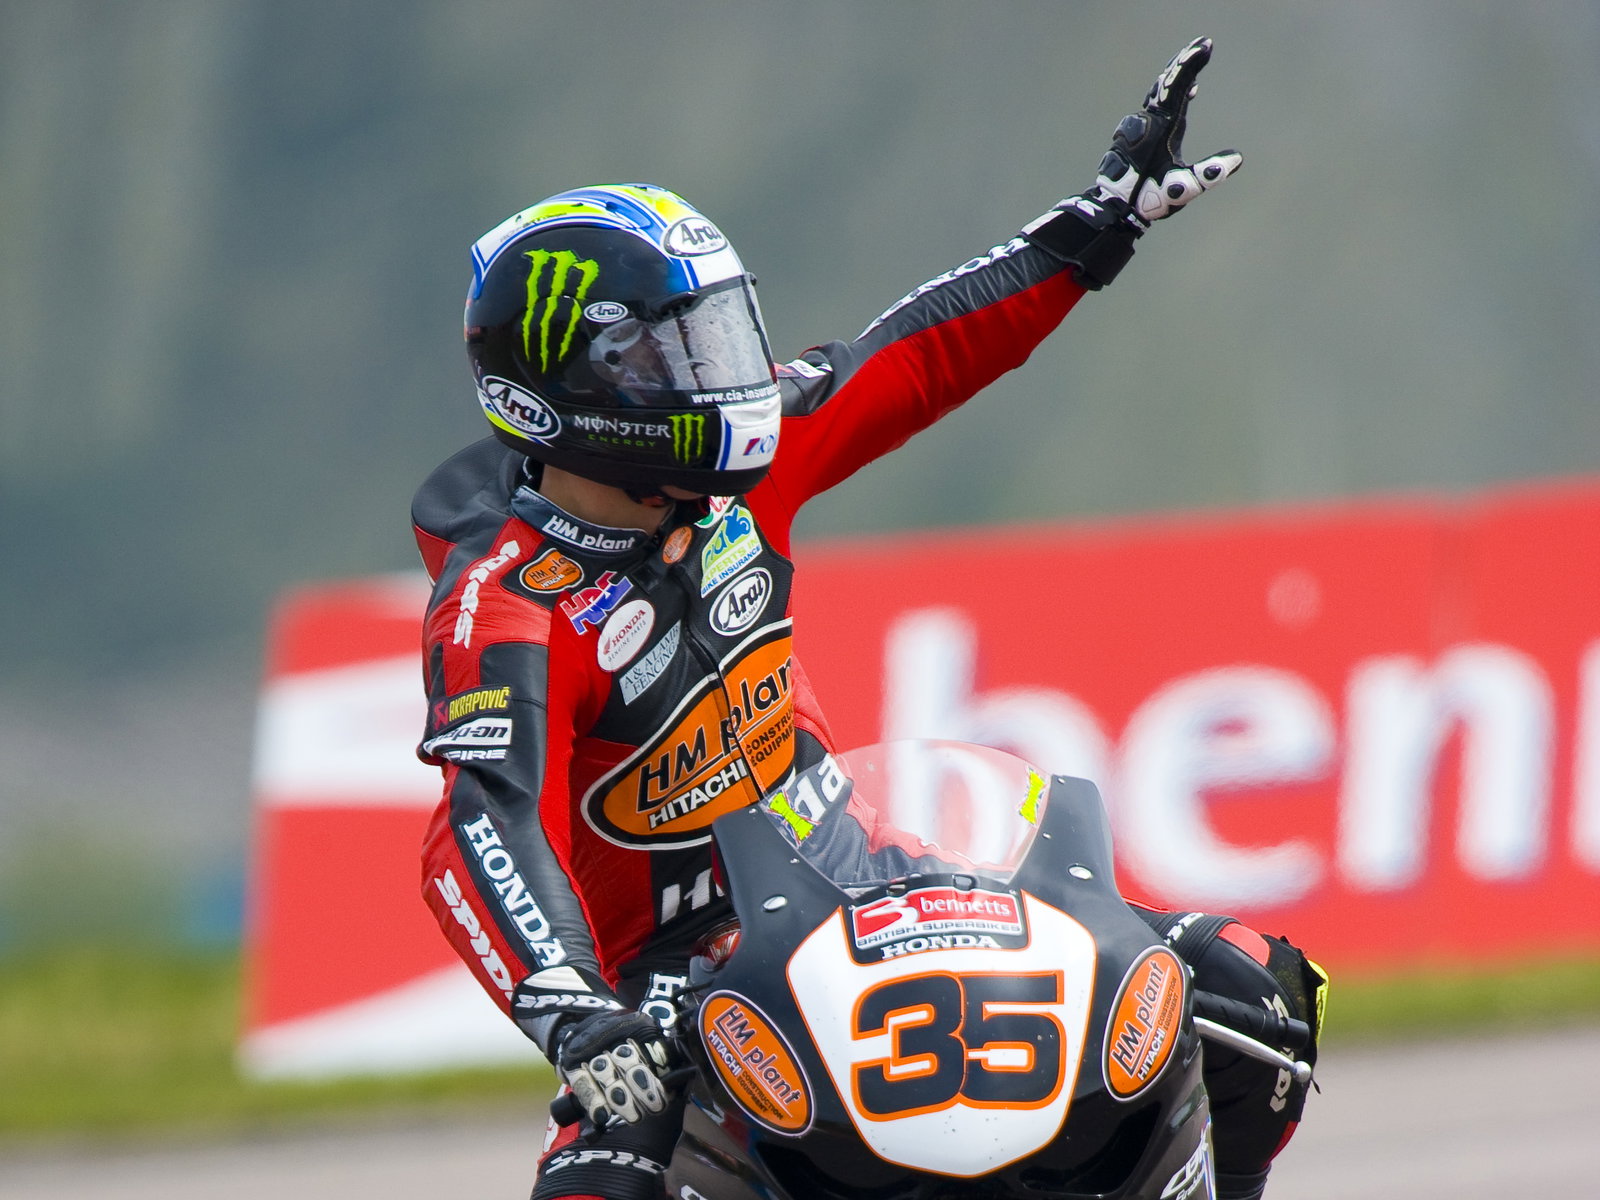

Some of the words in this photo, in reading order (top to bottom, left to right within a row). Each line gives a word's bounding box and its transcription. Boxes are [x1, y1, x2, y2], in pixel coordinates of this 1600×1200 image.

[588, 305, 620, 316] Arai
[491, 386, 549, 428] Arai
[503, 411, 532, 431] HELMET
[574, 415, 671, 438] MONSTER
[588, 434, 656, 447] ENERGY
[542, 515, 579, 541] HM
[580, 533, 636, 550] plant
[528, 569, 549, 584] HM
[719, 544, 761, 580] INSURANCE
[560, 570, 634, 636] HRC
[722, 572, 764, 630] Arai
[740, 602, 759, 624] HELMET
[608, 637, 631, 662] GENUINE
[631, 621, 647, 638] PARTS
[612, 608, 646, 648] HONDA
[624, 675, 634, 689] A
[633, 667, 644, 680] &
[643, 657, 653, 670] A
[632, 641, 678, 695] FENCING
[636, 724, 708, 814] HM
[880, 603, 1600, 915] ben
[649, 758, 750, 829] HITACHI
[463, 813, 567, 967] HONDA
[919, 897, 1011, 916] bennetts
[857, 927, 917, 947] BRITISH
[922, 921, 1021, 933] SUPERBIKES
[881, 934, 1001, 960] HONDA
[515, 994, 626, 1011] SPIDI
[1111, 1020, 1143, 1079] HM
[1135, 959, 1165, 1029] plant
[1157, 976, 1178, 1026] CONSTRUCTION
[1163, 993, 1179, 1031] EQUIPMENT
[707, 1029, 743, 1077] HITACHI
[713, 1003, 756, 1047] HM
[741, 1046, 802, 1106] plant
[852, 970, 1065, 1122] 35
[1137, 1027, 1166, 1080] HITACHI
[736, 1077, 769, 1113] EQUIPMENT
[741, 1071, 784, 1120] CONSTRUCTION
